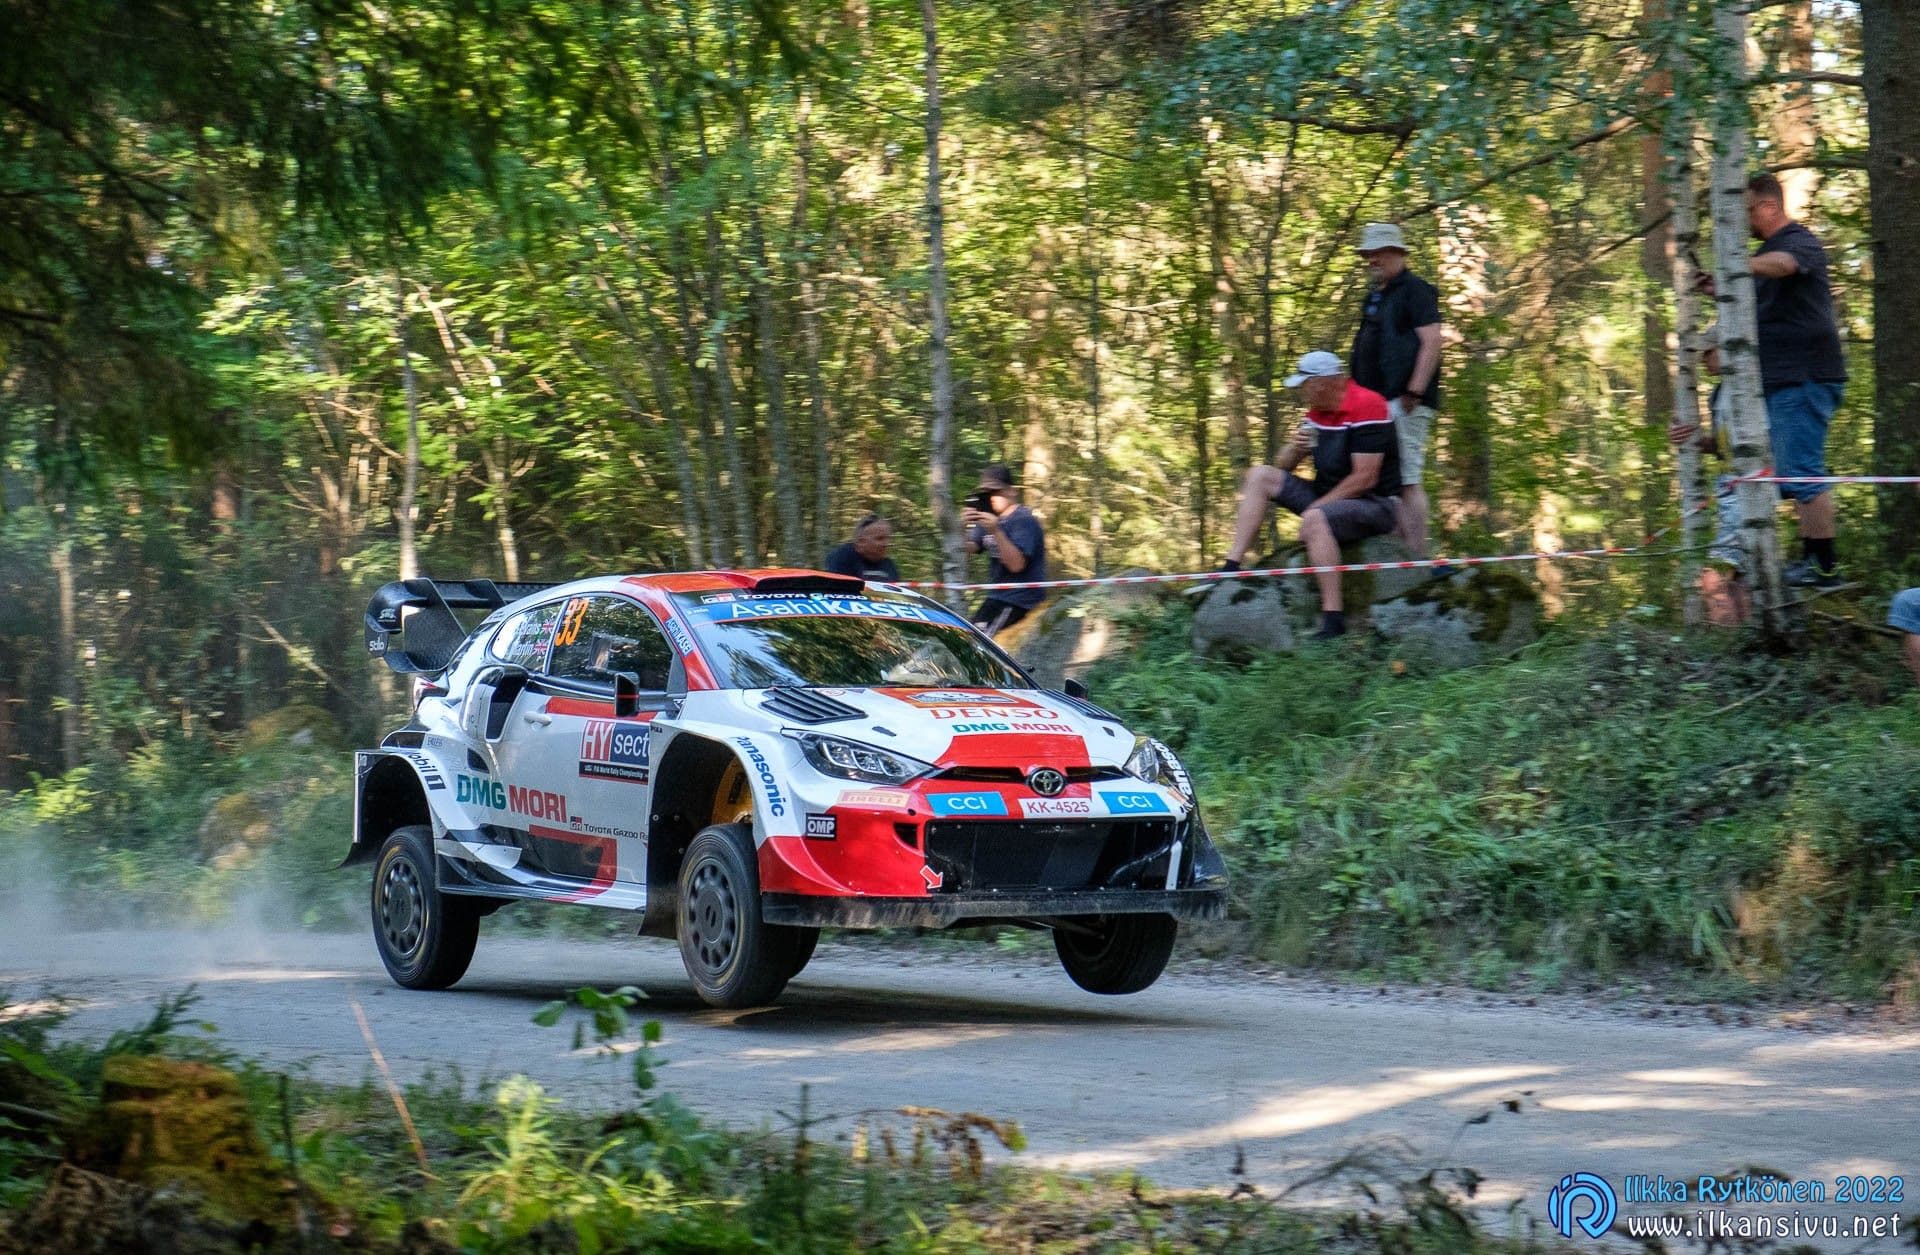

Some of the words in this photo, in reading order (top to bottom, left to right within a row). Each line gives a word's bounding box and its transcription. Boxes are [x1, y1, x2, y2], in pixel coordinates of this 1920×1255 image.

[731, 599, 930, 621] AsahiKASEI
[554, 597, 590, 647] 33
[929, 709, 1060, 719] DENSO
[952, 723, 1009, 733] DMG
[1011, 723, 1073, 733] MORI
[582, 721, 614, 760] HY
[613, 732, 650, 758] sect
[456, 774, 507, 810] DMG
[508, 784, 568, 823] MORI
[1026, 801, 1090, 814] KK-4525
[807, 820, 835, 834] OMP
